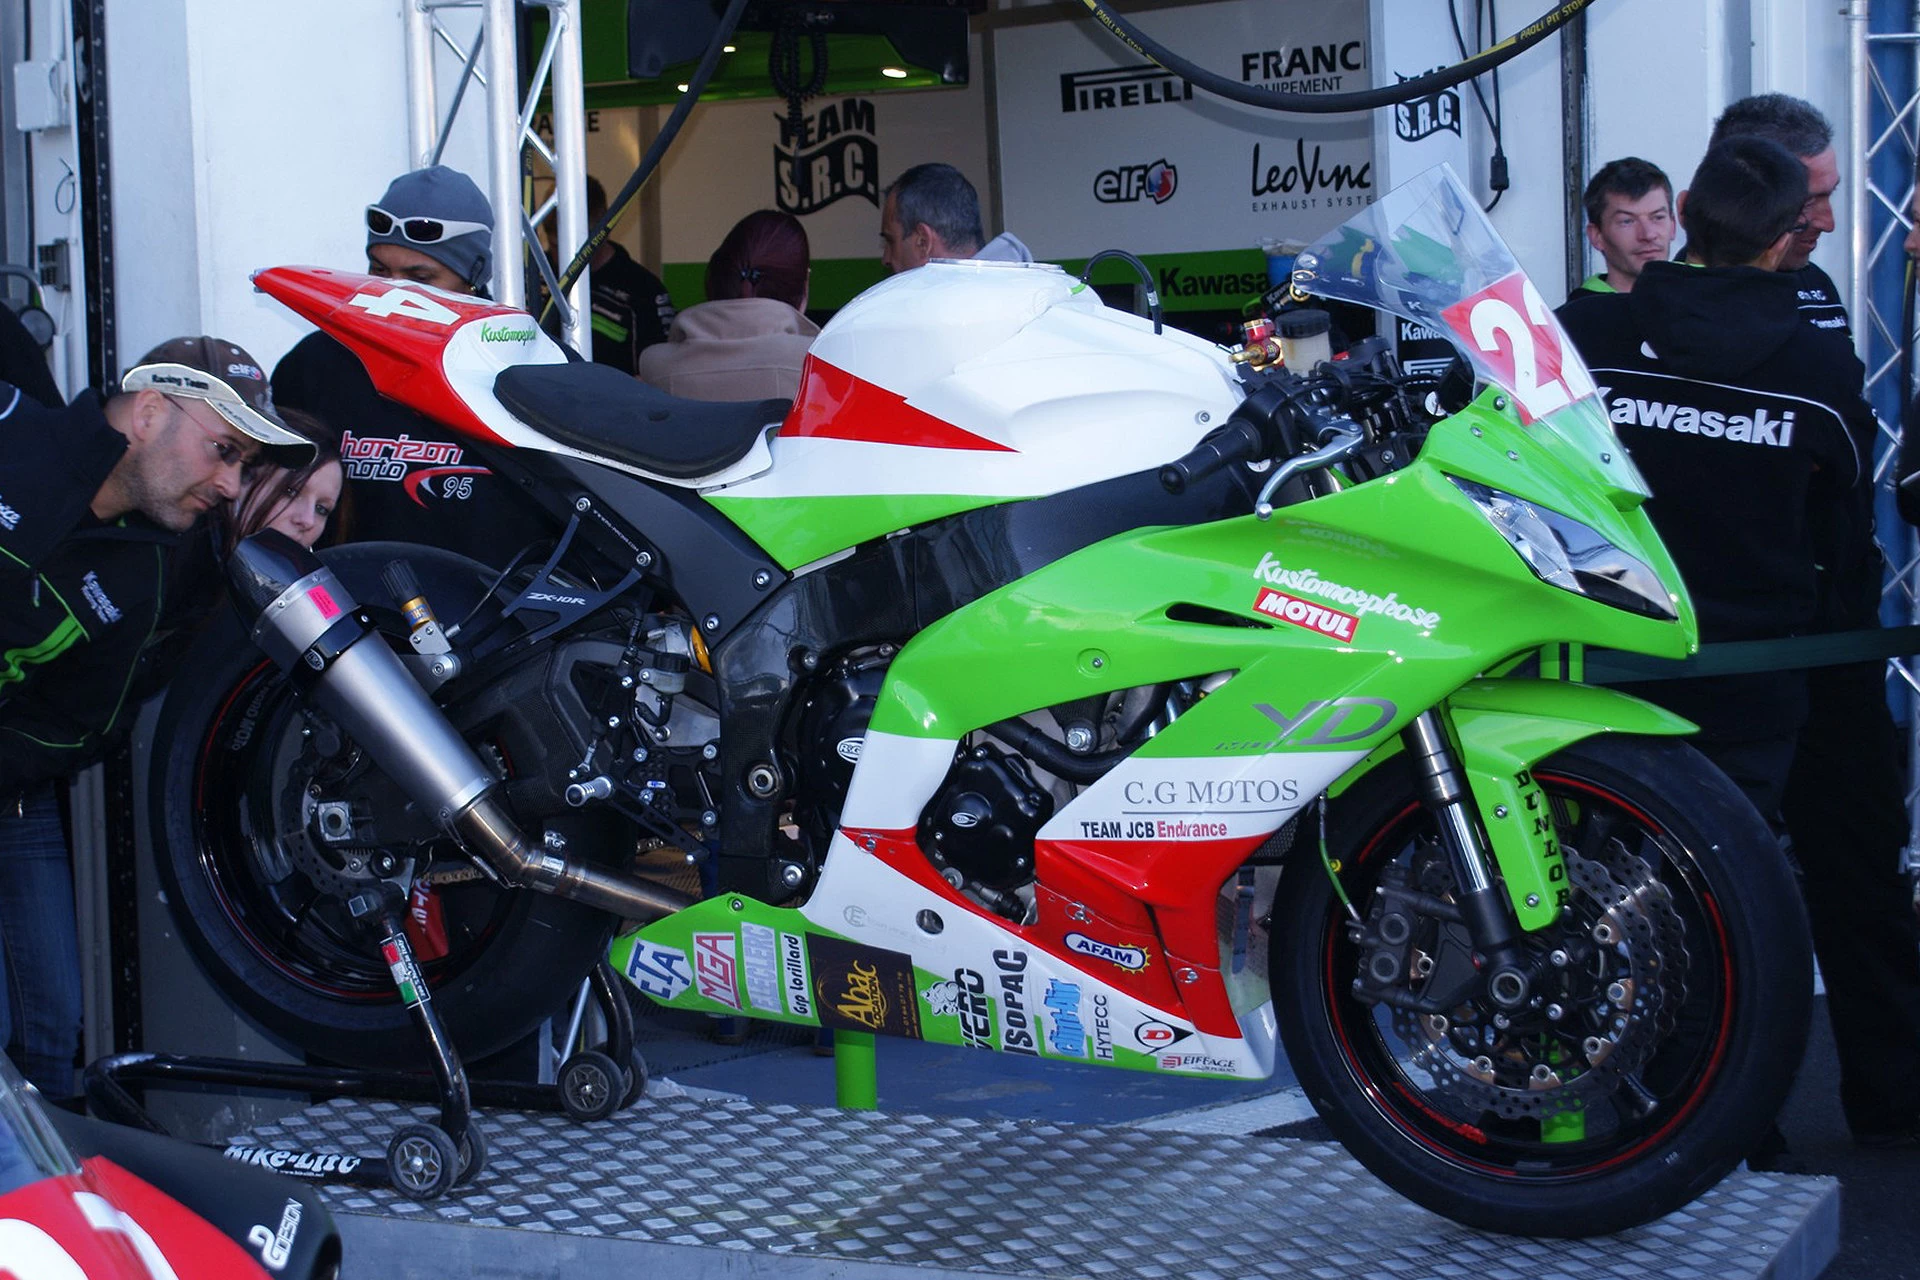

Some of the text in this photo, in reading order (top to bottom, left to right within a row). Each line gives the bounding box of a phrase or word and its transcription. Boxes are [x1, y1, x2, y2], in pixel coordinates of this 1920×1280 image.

[1519, 23, 1545, 40] PAOLI
[1545, 11, 1561, 26] PIT
[1241, 40, 1367, 82] FRANC
[1060, 63, 1193, 113] PIRELLI
[1396, 92, 1460, 139] S.R.C.
[1095, 165, 1151, 202] elf
[1251, 198, 1318, 214] EXHAUST
[151, 373, 182, 387] Racing
[1597, 386, 1795, 448] awasaki
[339, 430, 464, 465] horizon
[442, 476, 474, 501] 95
[526, 591, 587, 606] ZX-10R
[1253, 551, 1441, 629] Kustomorphose
[1258, 592, 1351, 638] MOTUL
[1186, 778, 1299, 805] MOTOS
[1080, 820, 1122, 840] TEAM
[1125, 820, 1156, 840] JCB
[1512, 768, 1571, 908] DUNLOP
[1076, 939, 1133, 964] AFAM
[992, 949, 1039, 1057] ISOPAC
[1183, 1055, 1236, 1069] EIFFAGE
